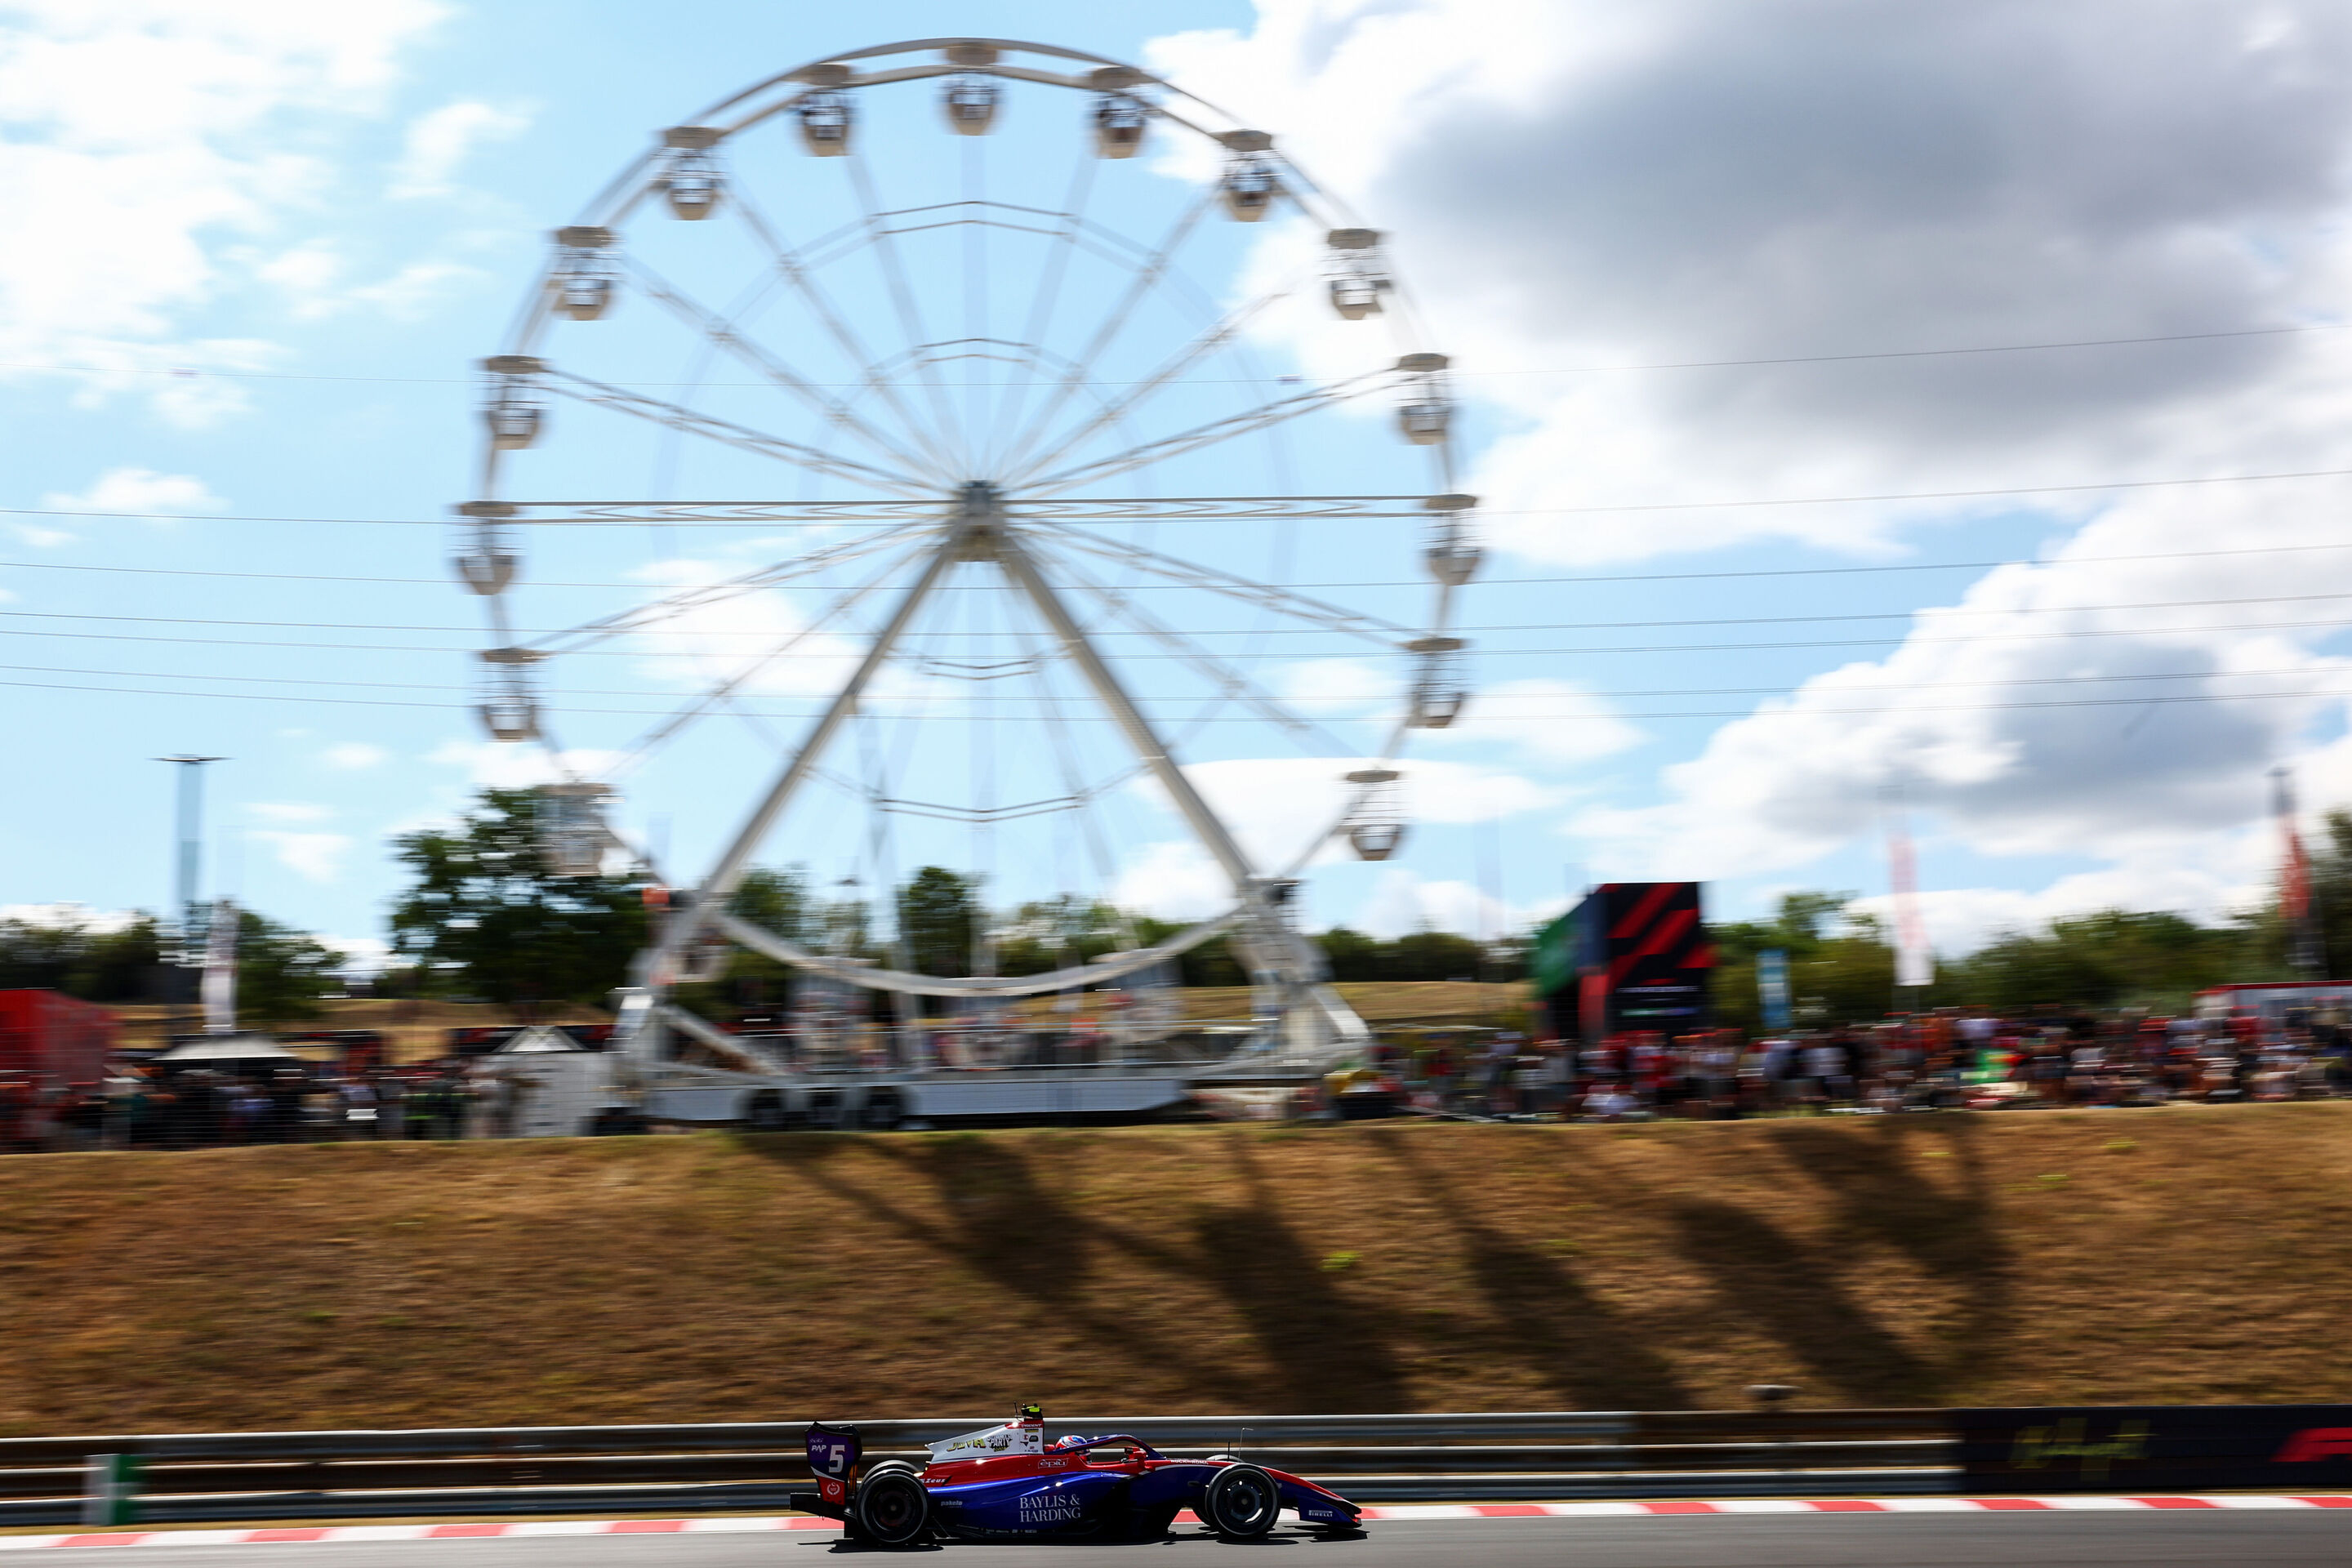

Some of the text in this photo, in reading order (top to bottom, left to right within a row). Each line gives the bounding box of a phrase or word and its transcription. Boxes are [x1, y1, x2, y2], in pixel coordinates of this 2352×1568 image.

[989, 1437, 1011, 1447] PARTY
[829, 1445, 845, 1473] 5
[1019, 1494, 1081, 1509] BAYLIS &
[1019, 1507, 1081, 1523] HARDING
